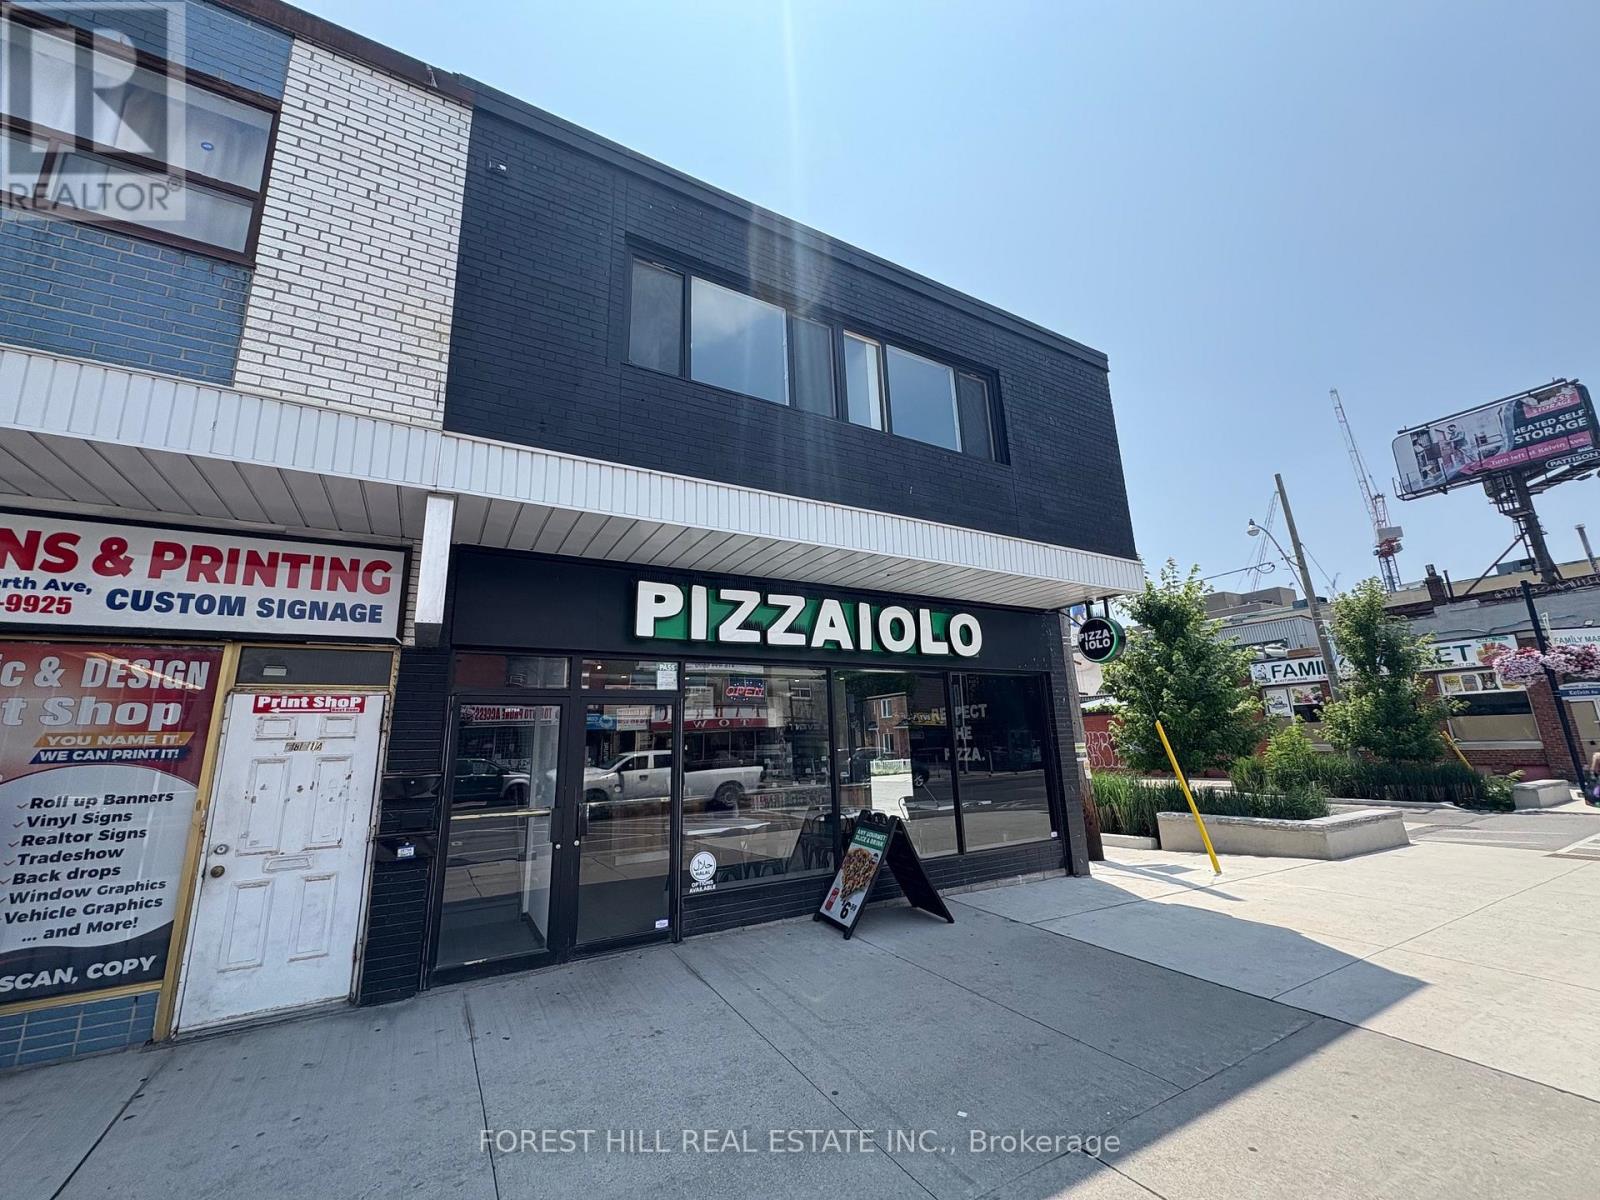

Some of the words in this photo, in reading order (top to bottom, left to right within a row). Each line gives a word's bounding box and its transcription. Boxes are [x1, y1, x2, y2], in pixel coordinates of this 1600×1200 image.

[1512, 418, 1556, 436] HEATED
[1558, 409, 1585, 422] SELF
[1514, 417, 1588, 444] STORAGE
[1550, 452, 1599, 467] PATTISON
[92, 536, 134, 577] &
[148, 541, 393, 595] PRINTING
[0, 577, 37, 590] rth
[43, 578, 93, 595] Ave,
[105, 588, 246, 617] CUSTOM
[256, 597, 383, 624] SIGNAGE
[635, 580, 982, 657] PIZZAIOLO
[1085, 639, 1111, 650] IOLO
[34, 656, 66, 688] &
[80, 657, 210, 690] DESIGN
[660, 664, 675, 672] PASS
[726, 686, 764, 697] OPEN
[257, 695, 309, 708] Print
[39, 696, 182, 732] Shop
[931, 703, 987, 720] REPECT
[47, 735, 92, 746] YOU
[97, 735, 156, 745] NAME
[955, 726, 973, 740] HE
[39, 751, 68, 761] WE
[72, 750, 107, 760] CAN
[112, 749, 160, 760] PRINT
[160, 748, 180, 758] IT!
[945, 747, 986, 761] PZZA.
[29, 795, 67, 809] Roll
[73, 796, 98, 809] up
[103, 792, 174, 806] Banners
[27, 813, 77, 829] Vinyl
[82, 811, 133, 826] Signs
[21, 831, 93, 847] Realtor
[98, 828, 147, 843] Signs
[17, 848, 124, 866] Tradeshow
[12, 869, 61, 885] Back
[66, 866, 121, 881] drops
[9, 886, 92, 905] Window
[97, 879, 166, 896] Graphics
[4, 906, 77, 925] Vehicle
[83, 897, 163, 916] Graphics
[43, 922, 81, 940] and
[86, 916, 138, 935] More!
[0, 967, 78, 993] SCAN,
[86, 955, 157, 980] COPY
